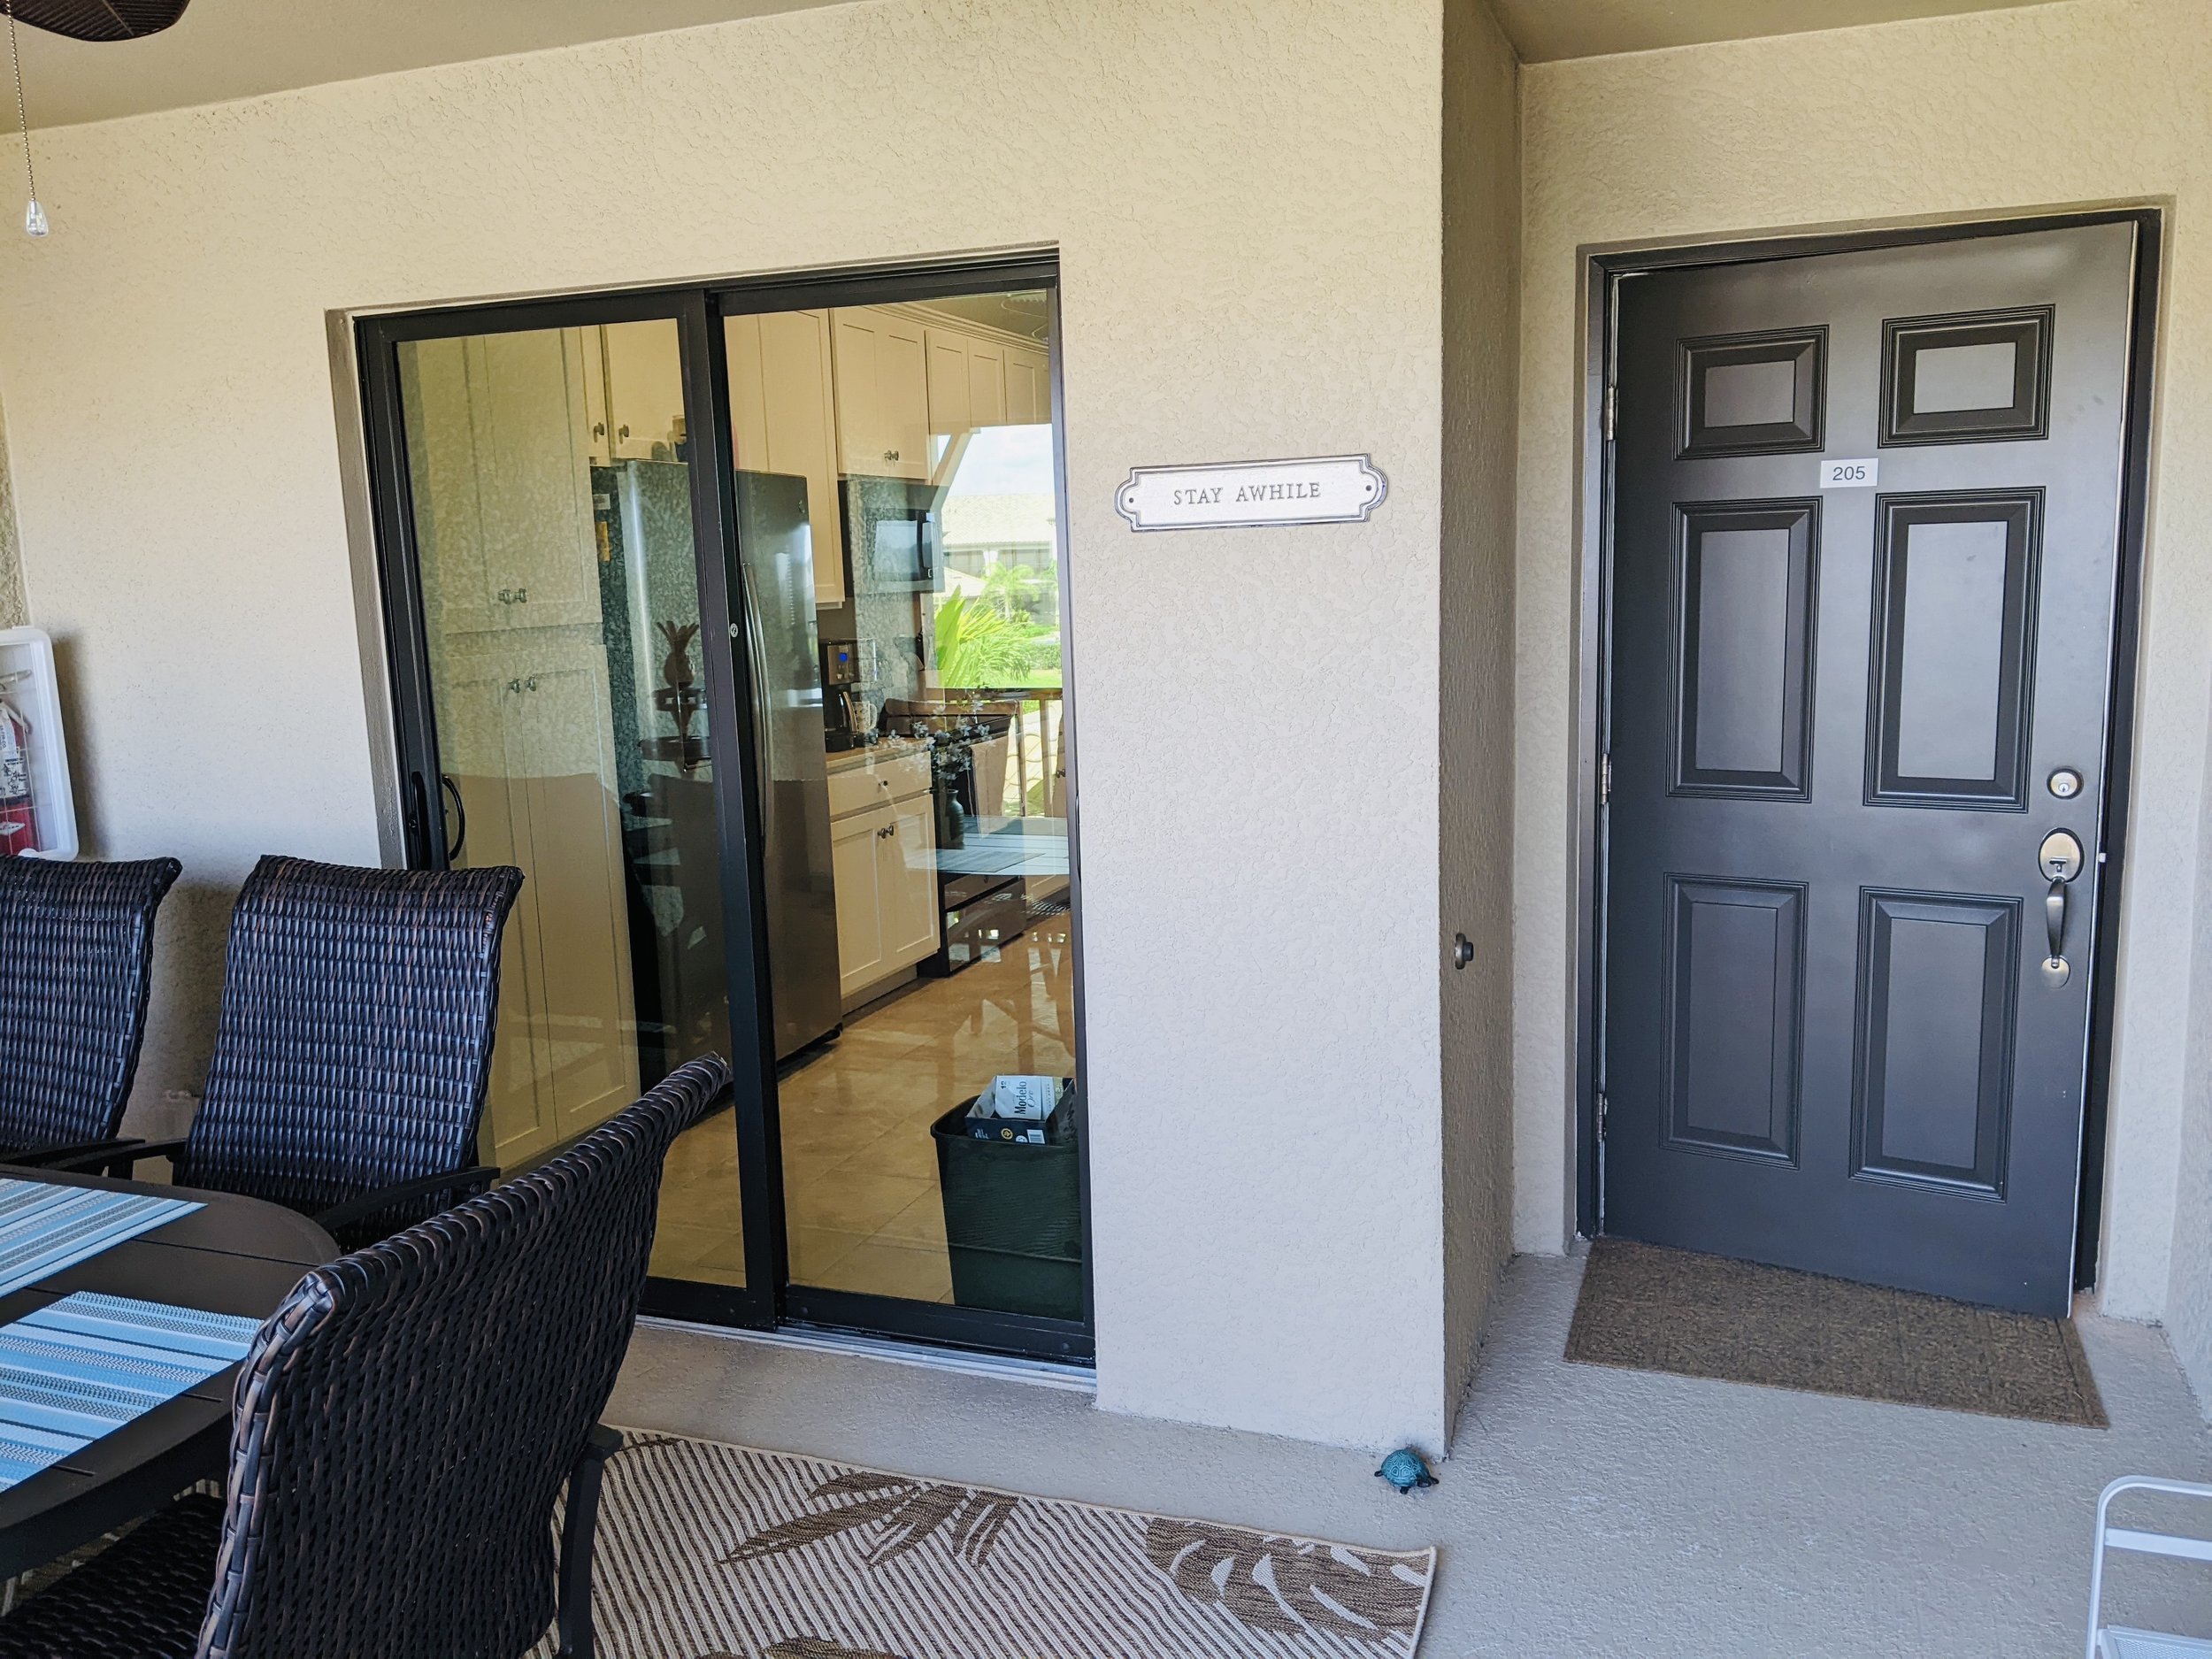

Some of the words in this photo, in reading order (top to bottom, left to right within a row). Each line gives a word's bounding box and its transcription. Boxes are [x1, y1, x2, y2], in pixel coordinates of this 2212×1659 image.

[1832, 465, 1866, 480] 205
[1173, 487, 1223, 505] STAY
[1235, 482, 1321, 503] AWHILE
[1001, 1080, 1007, 1089] 12
[1014, 1081, 1026, 1115] Modelo
